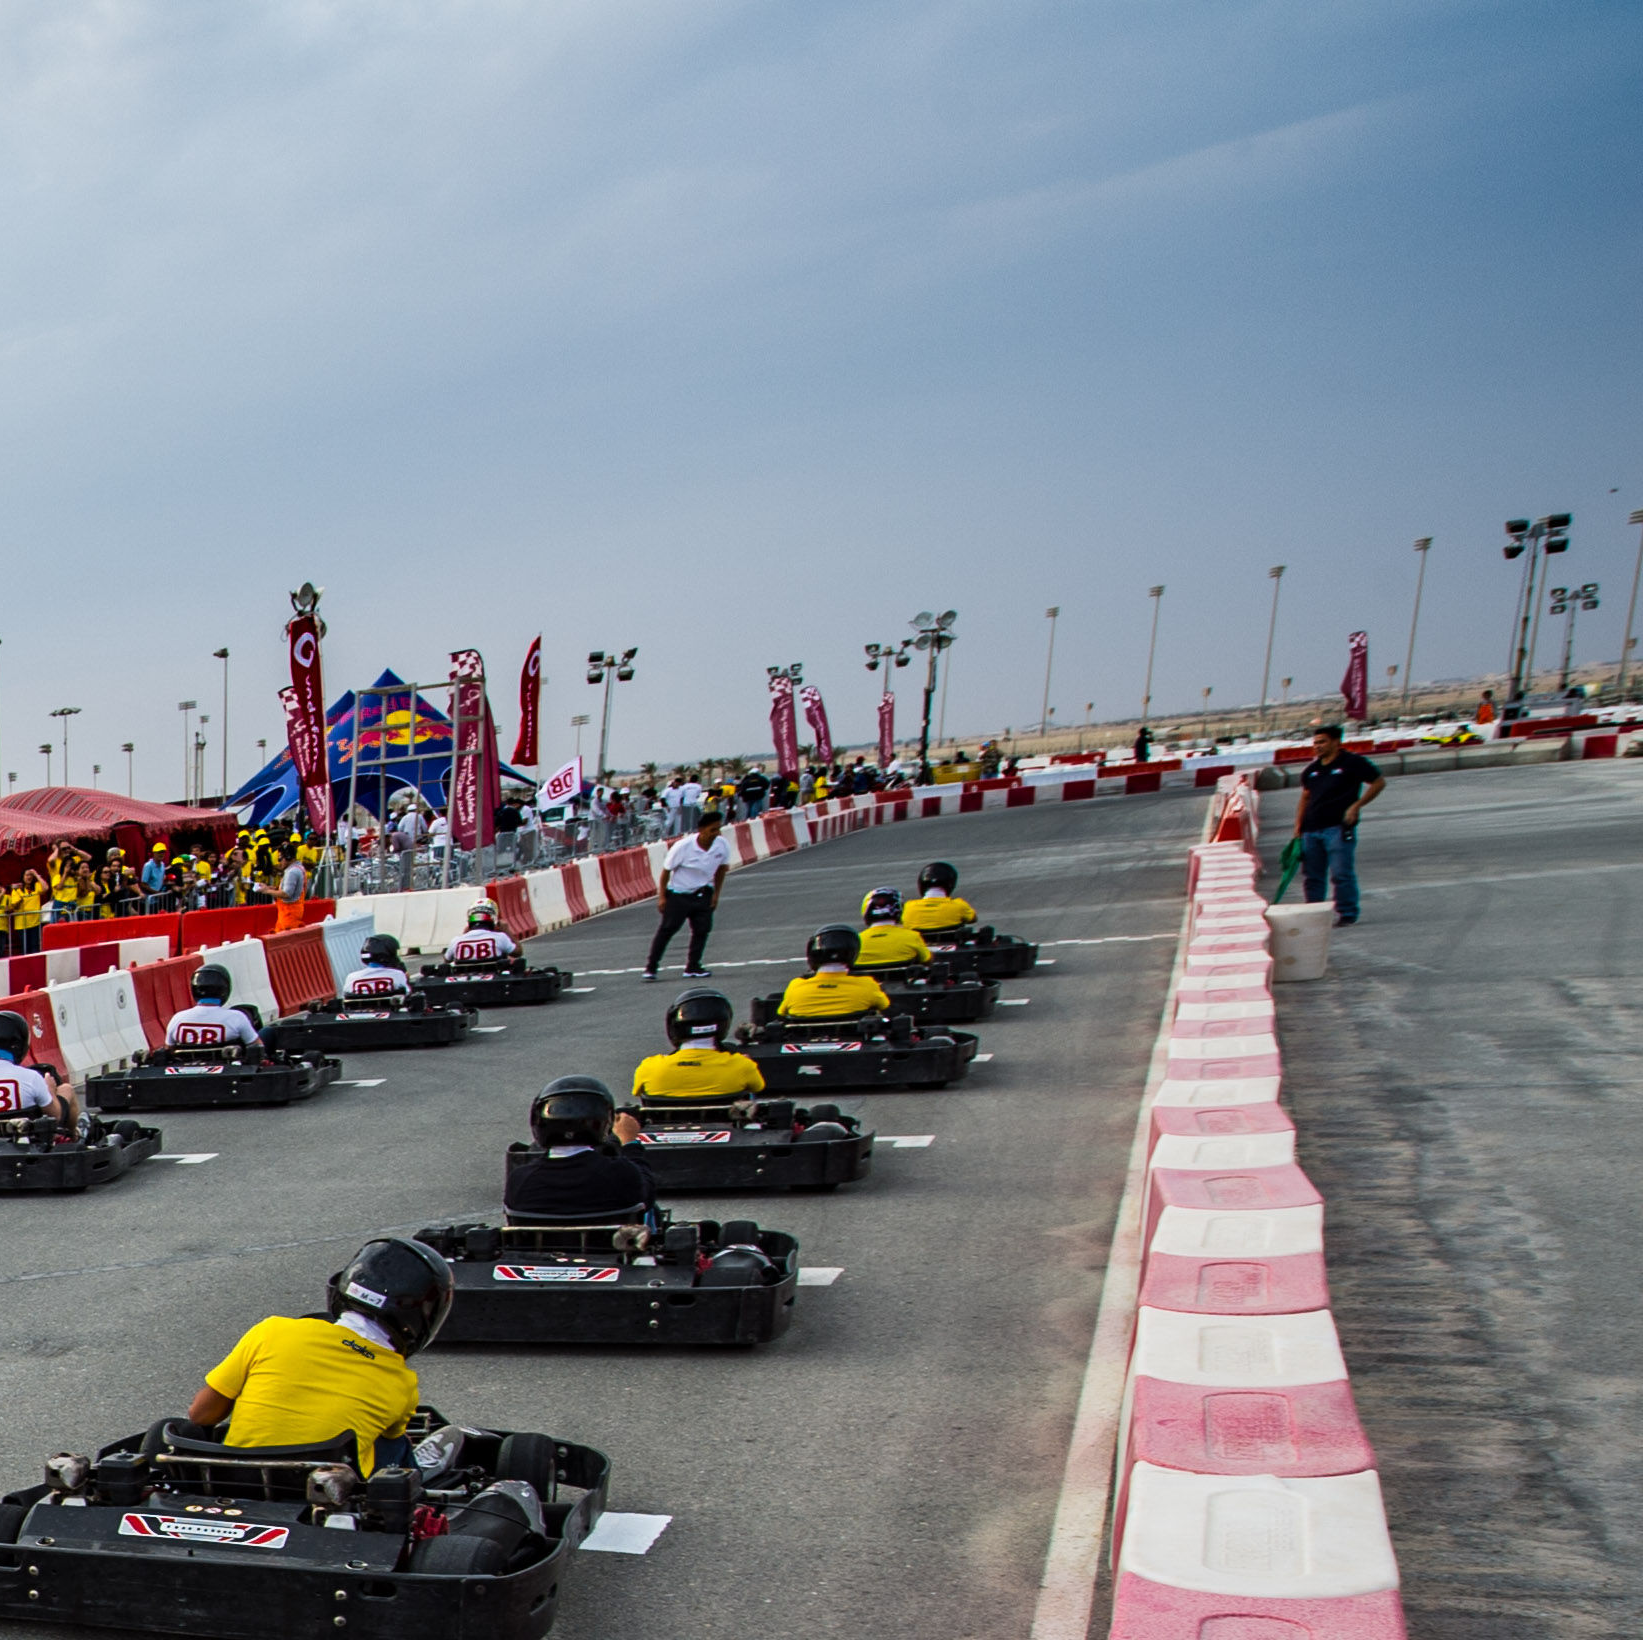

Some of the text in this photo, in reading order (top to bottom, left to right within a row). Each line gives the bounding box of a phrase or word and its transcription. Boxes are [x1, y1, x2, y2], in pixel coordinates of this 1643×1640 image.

[460, 942, 491, 960] DB
[181, 1028, 218, 1045] DB
[342, 1339, 376, 1361] doka
